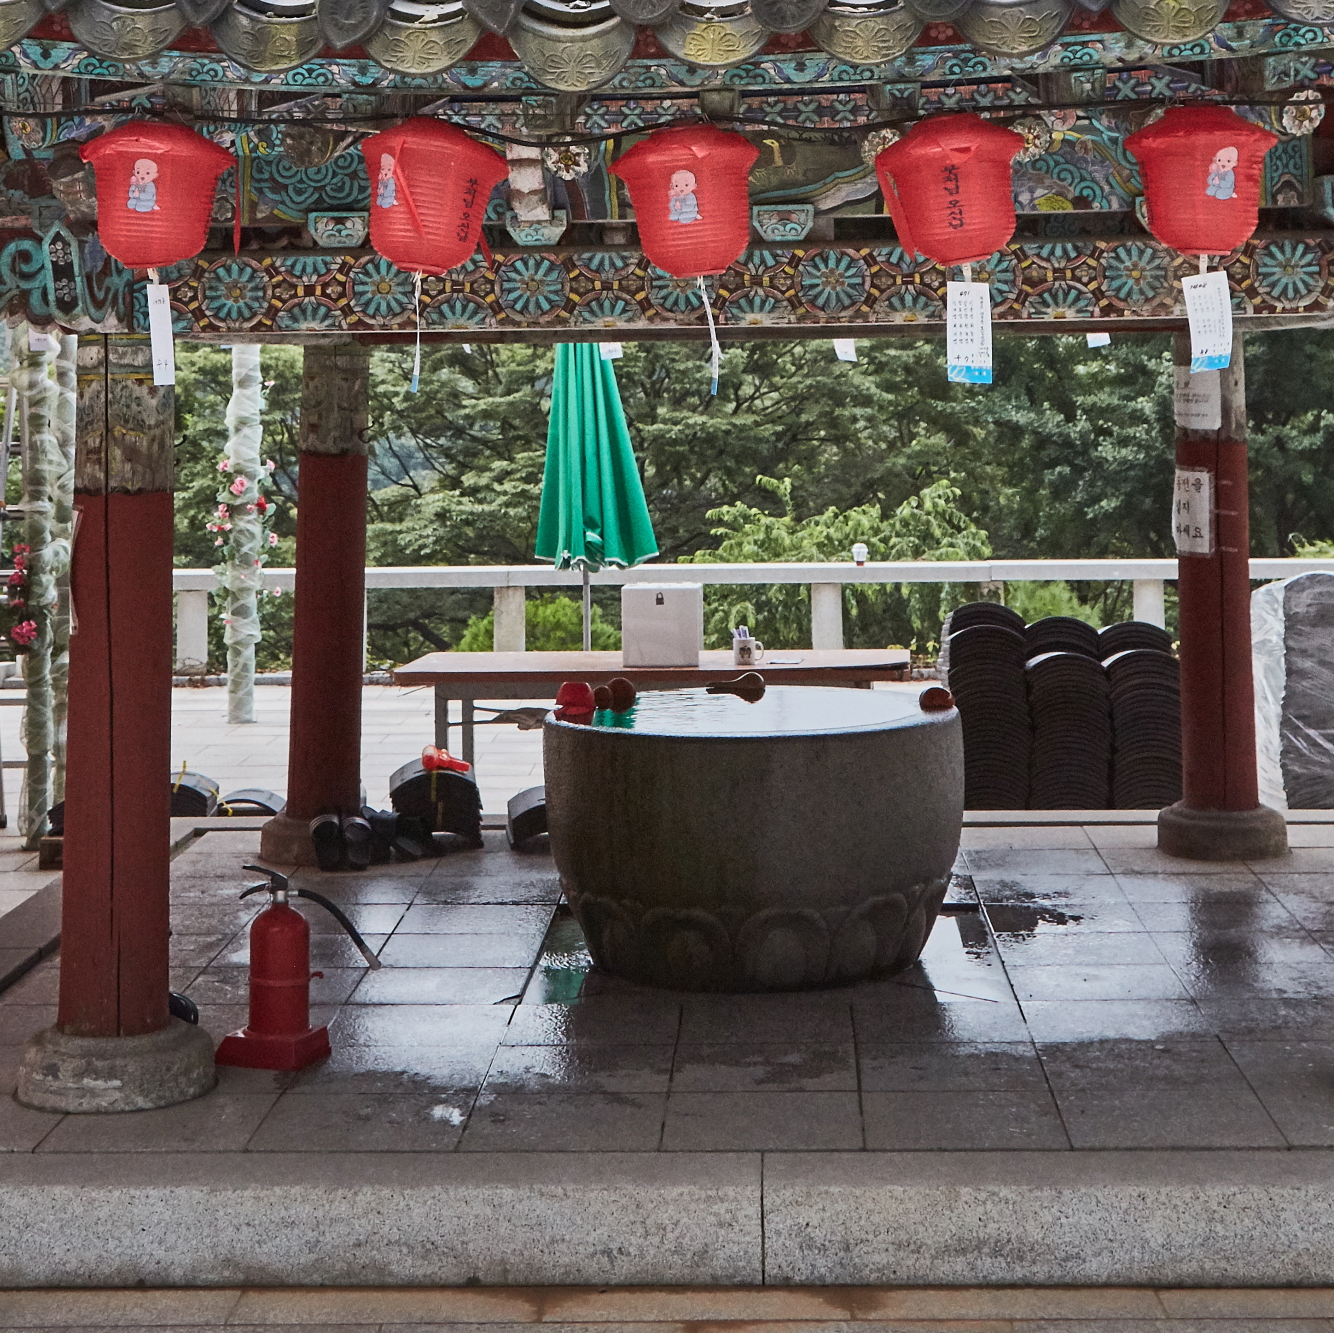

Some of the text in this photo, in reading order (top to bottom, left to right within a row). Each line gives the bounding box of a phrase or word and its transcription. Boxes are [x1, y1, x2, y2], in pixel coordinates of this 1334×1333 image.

[456, 178, 479, 243] 부처님 오신날
[942, 165, 966, 230] 부처님 오신날
